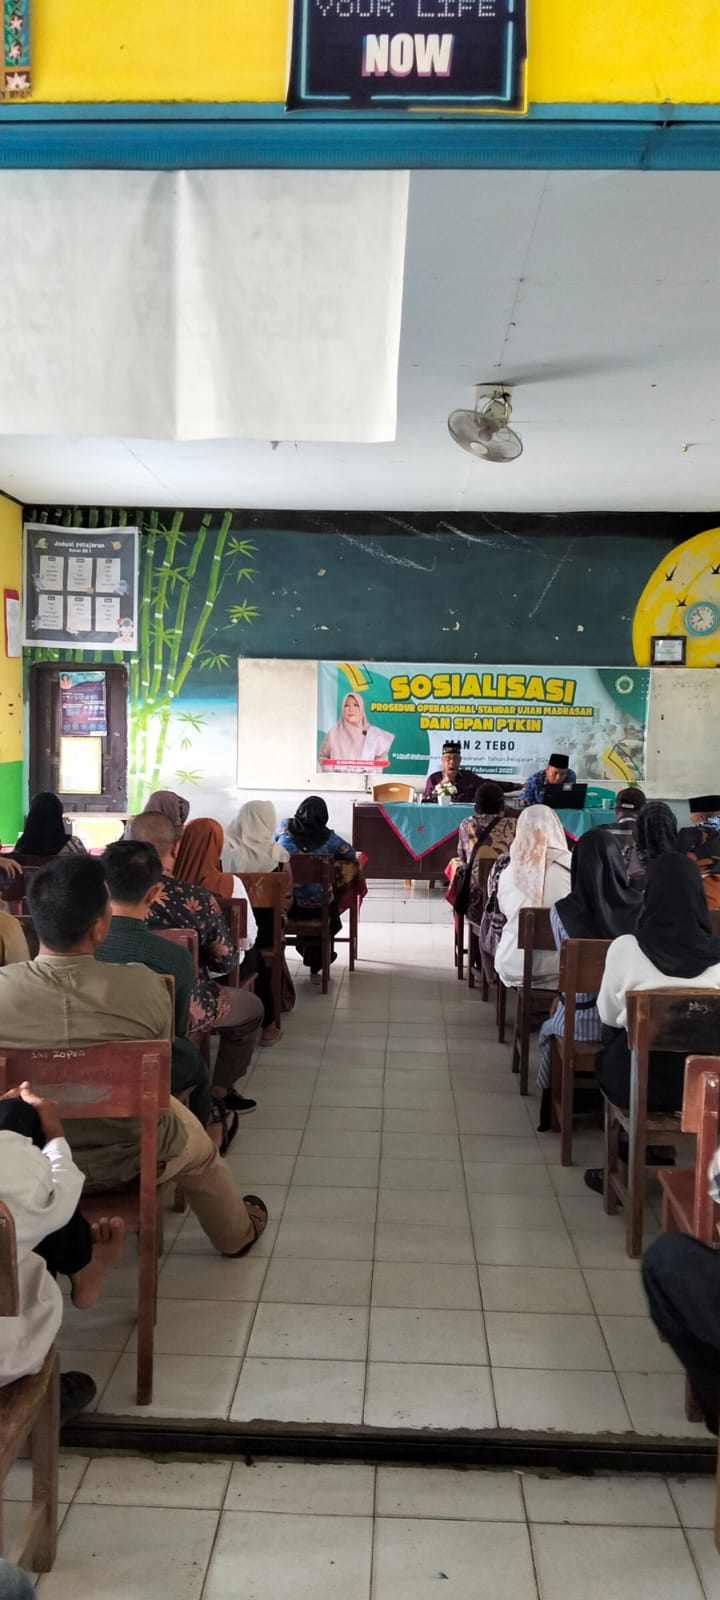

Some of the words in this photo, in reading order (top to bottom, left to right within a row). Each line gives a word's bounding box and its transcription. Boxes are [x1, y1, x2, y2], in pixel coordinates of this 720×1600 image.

[315, 0, 395, 17] YOUR
[417, 0, 497, 18] LIFE
[362, 32, 454, 77] NOW
[390, 673, 577, 705] SOSIALISASI
[370, 702, 416, 713] PROSEDUR
[417, 703, 476, 714] OPERASIONAL
[477, 704, 516, 715] STANDAR
[517, 705, 543, 716] UJIAN
[543, 706, 593, 717] MADRASAH
[419, 716, 451, 731] DAN
[453, 717, 494, 732] SPAN
[496, 717, 543, 733] PTKIN
[474, 740, 481, 750] 2
[485, 741, 515, 751] TEBO
[471, 766, 498, 774] Februari
